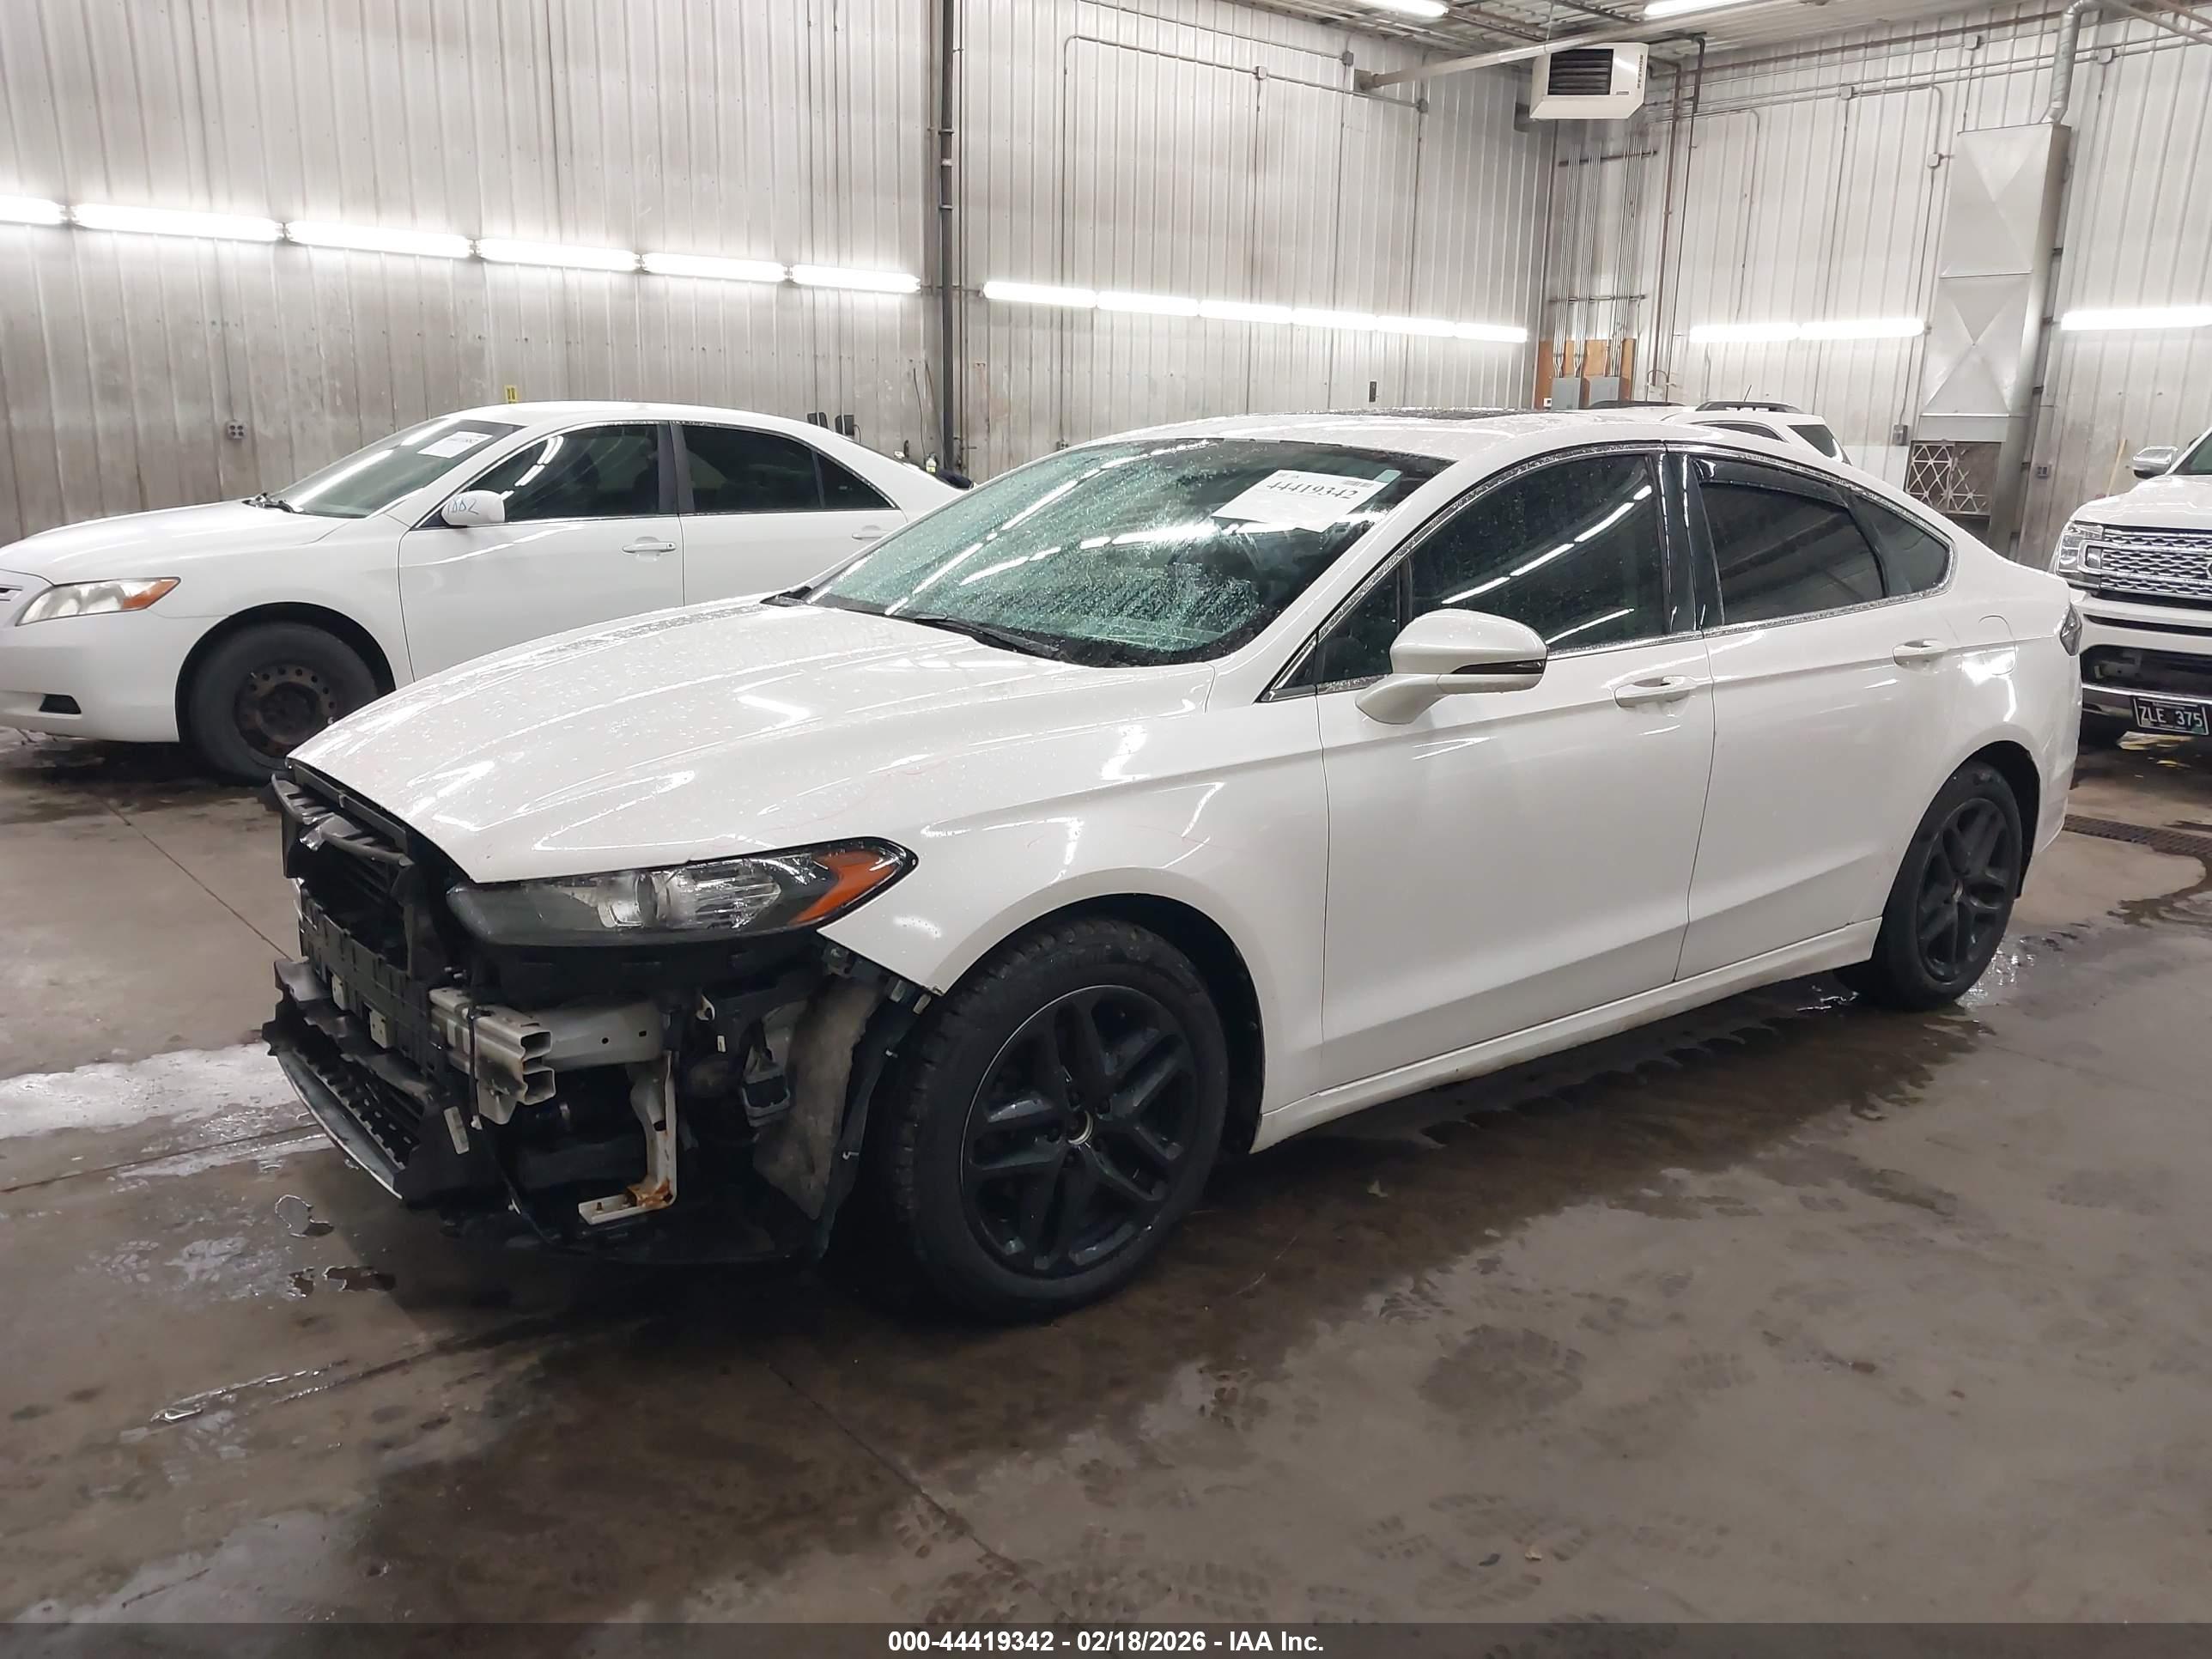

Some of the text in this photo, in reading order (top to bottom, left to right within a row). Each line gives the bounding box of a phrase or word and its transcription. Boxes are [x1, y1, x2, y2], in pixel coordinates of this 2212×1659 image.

[1267, 481, 1358, 500] 44419342
[2138, 705, 2166, 723] ZLE
[2175, 710, 2203, 727] 375
